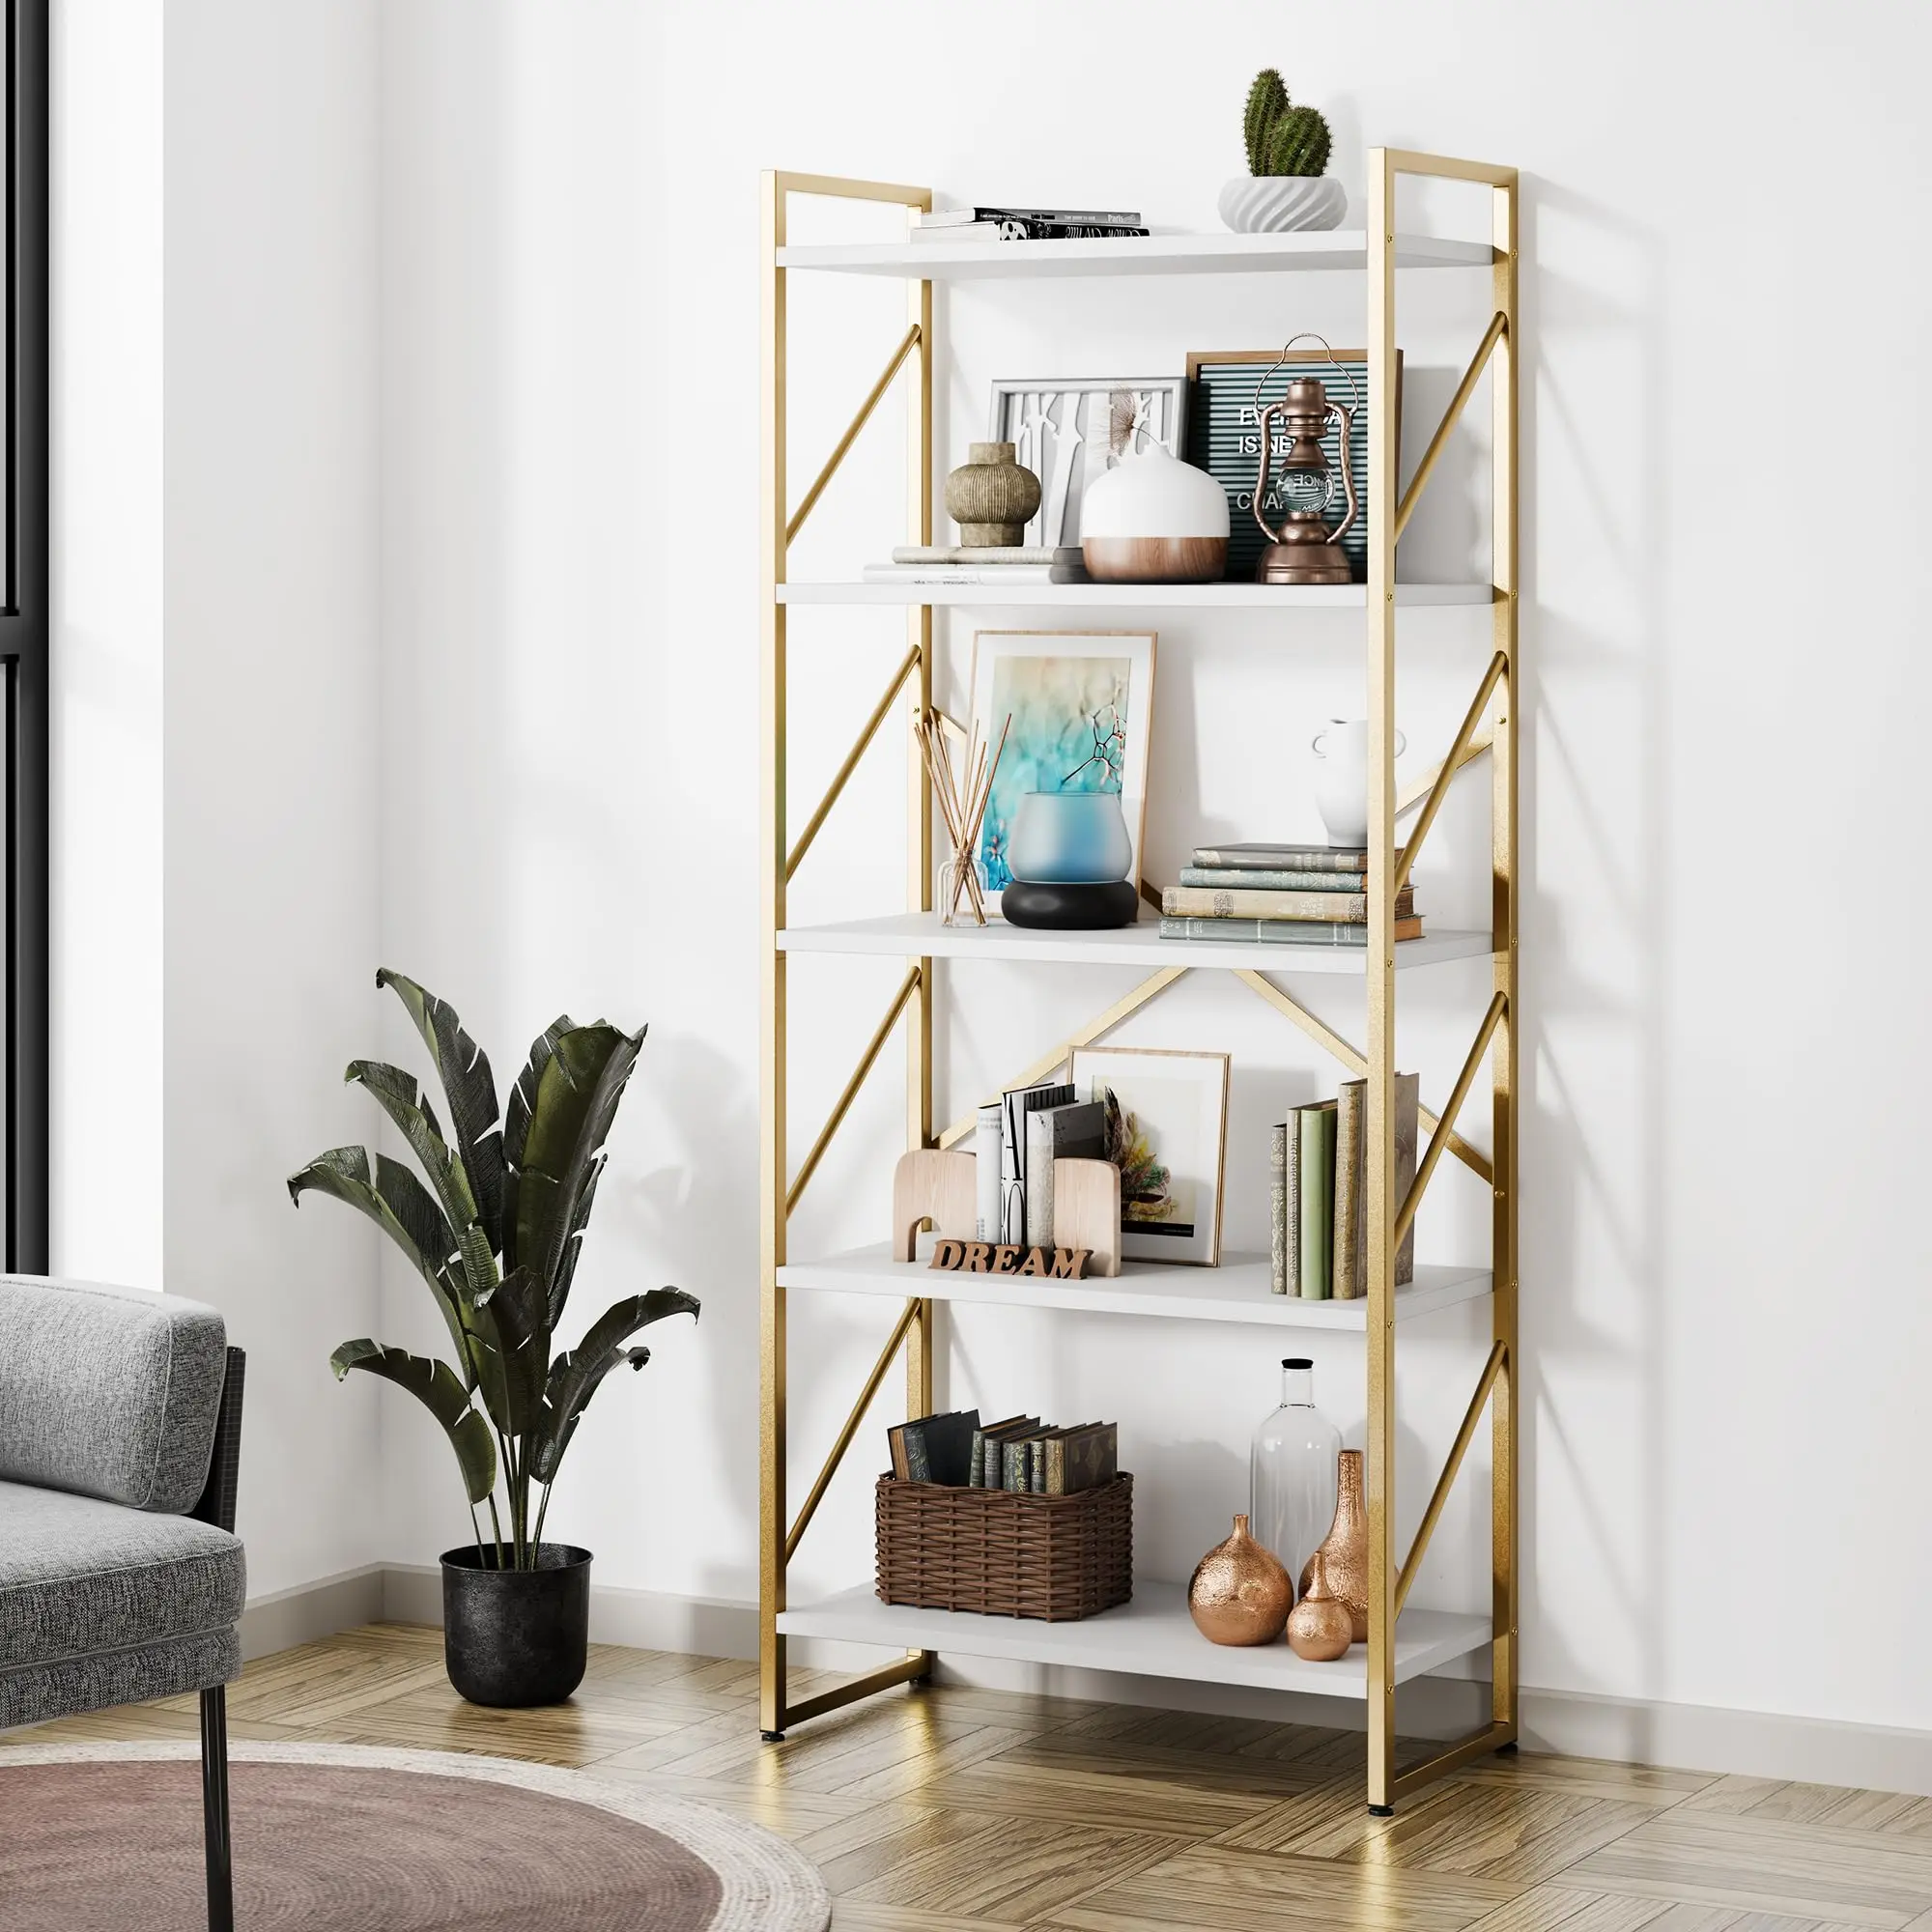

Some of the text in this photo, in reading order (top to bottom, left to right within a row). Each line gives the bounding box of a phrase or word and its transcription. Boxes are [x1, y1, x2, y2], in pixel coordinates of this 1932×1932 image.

[1238, 436, 1295, 453] IS NE
[928, 1239, 1093, 1280] DREAM
